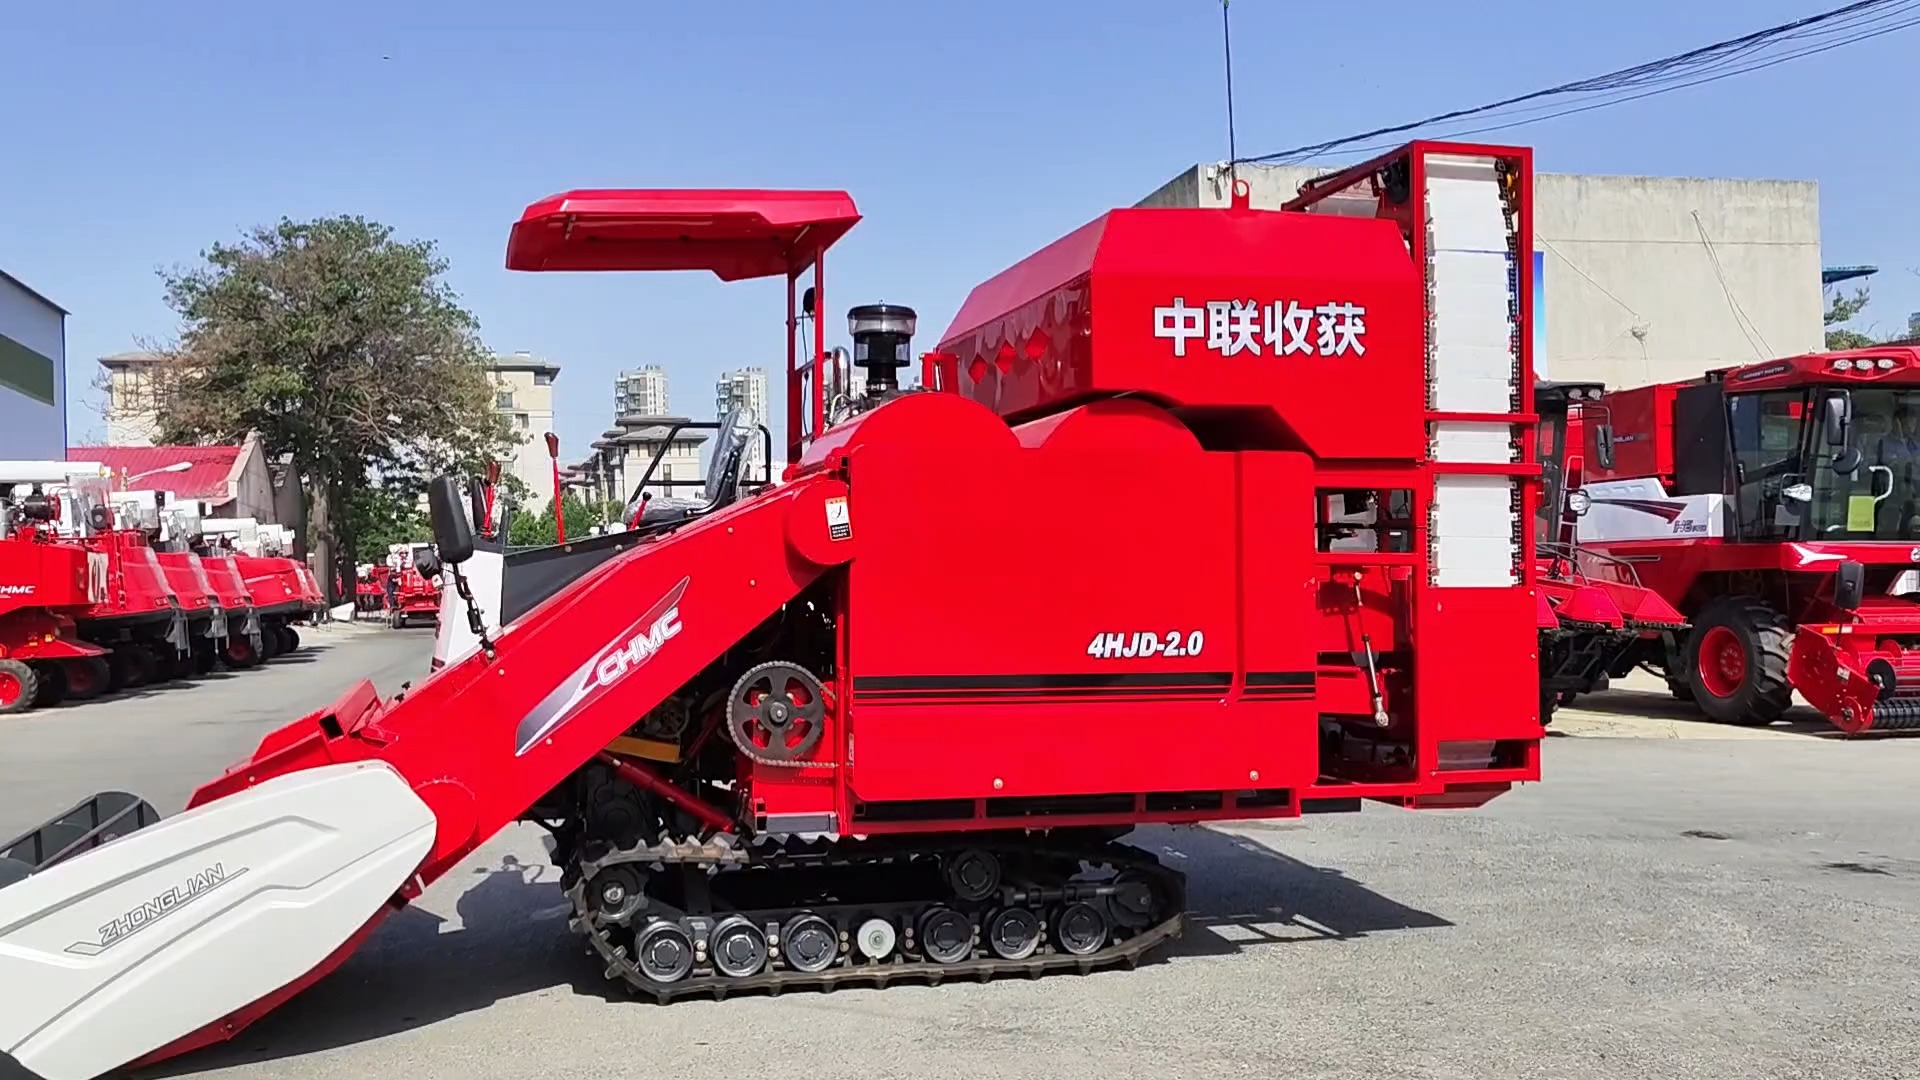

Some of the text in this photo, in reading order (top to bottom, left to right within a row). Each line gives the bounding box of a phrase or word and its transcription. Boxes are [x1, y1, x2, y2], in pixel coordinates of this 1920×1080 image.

[1154, 297, 1366, 357] 中联收获
[0, 585, 36, 594] HMC
[597, 606, 682, 686] CHMC
[1087, 630, 1204, 658] 4HJD-2.0
[98, 862, 225, 946] ZHONGLIAN
